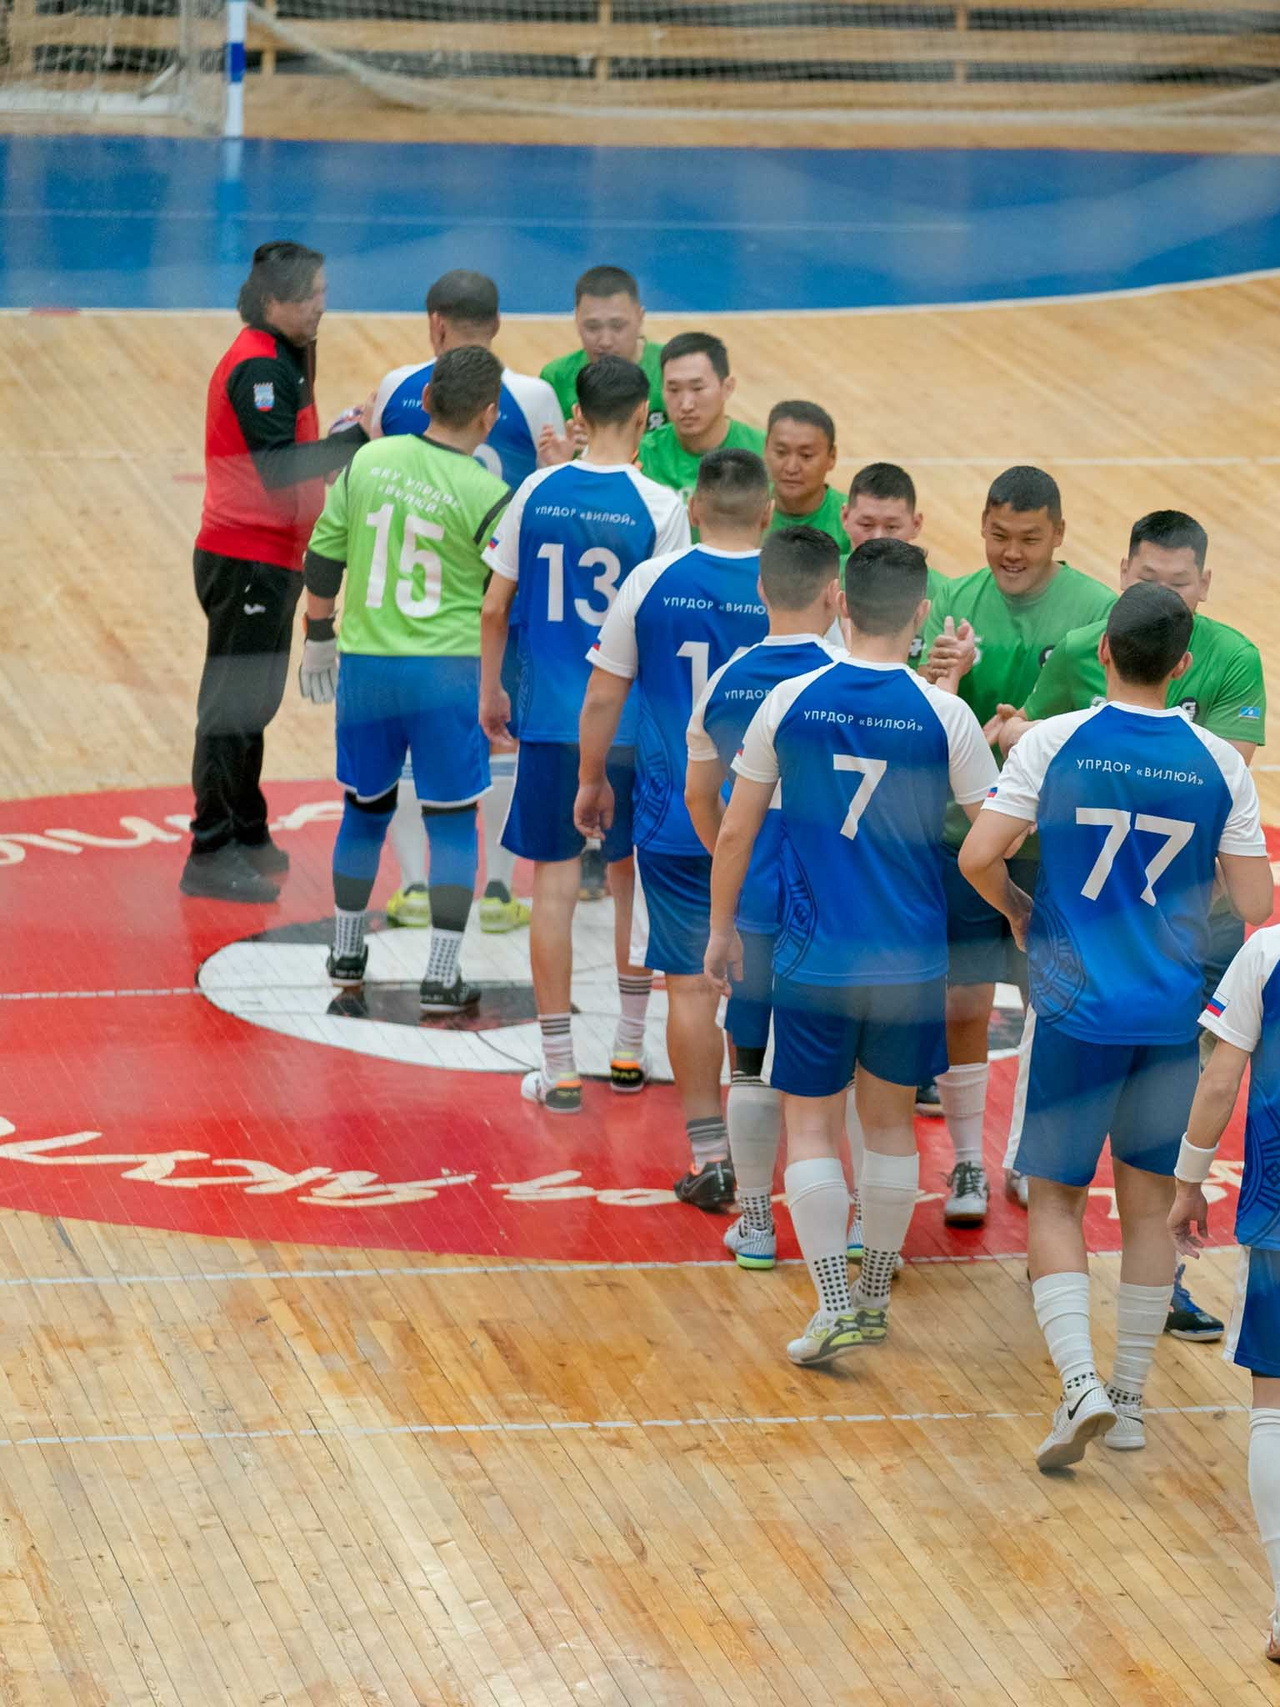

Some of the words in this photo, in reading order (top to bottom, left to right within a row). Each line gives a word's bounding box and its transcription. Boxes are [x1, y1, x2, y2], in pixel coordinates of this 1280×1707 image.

[534, 505, 576, 518] УПРДОР
[579, 510, 636, 526] «ВИЛЮЙ»
[364, 503, 446, 619] 15
[536, 542, 622, 628] 13
[663, 596, 714, 611] УПРДОР
[718, 602, 768, 616] «ВИЛЮ
[803, 710, 855, 725] УПРДОР
[858, 717, 923, 732] «ВИЛЮЙ»
[833, 753, 887, 841] 7
[1076, 759, 1132, 774] УПРДОР
[1136, 766, 1205, 786] «ВИЛЮЙ»
[1075, 806, 1196, 908] 77
